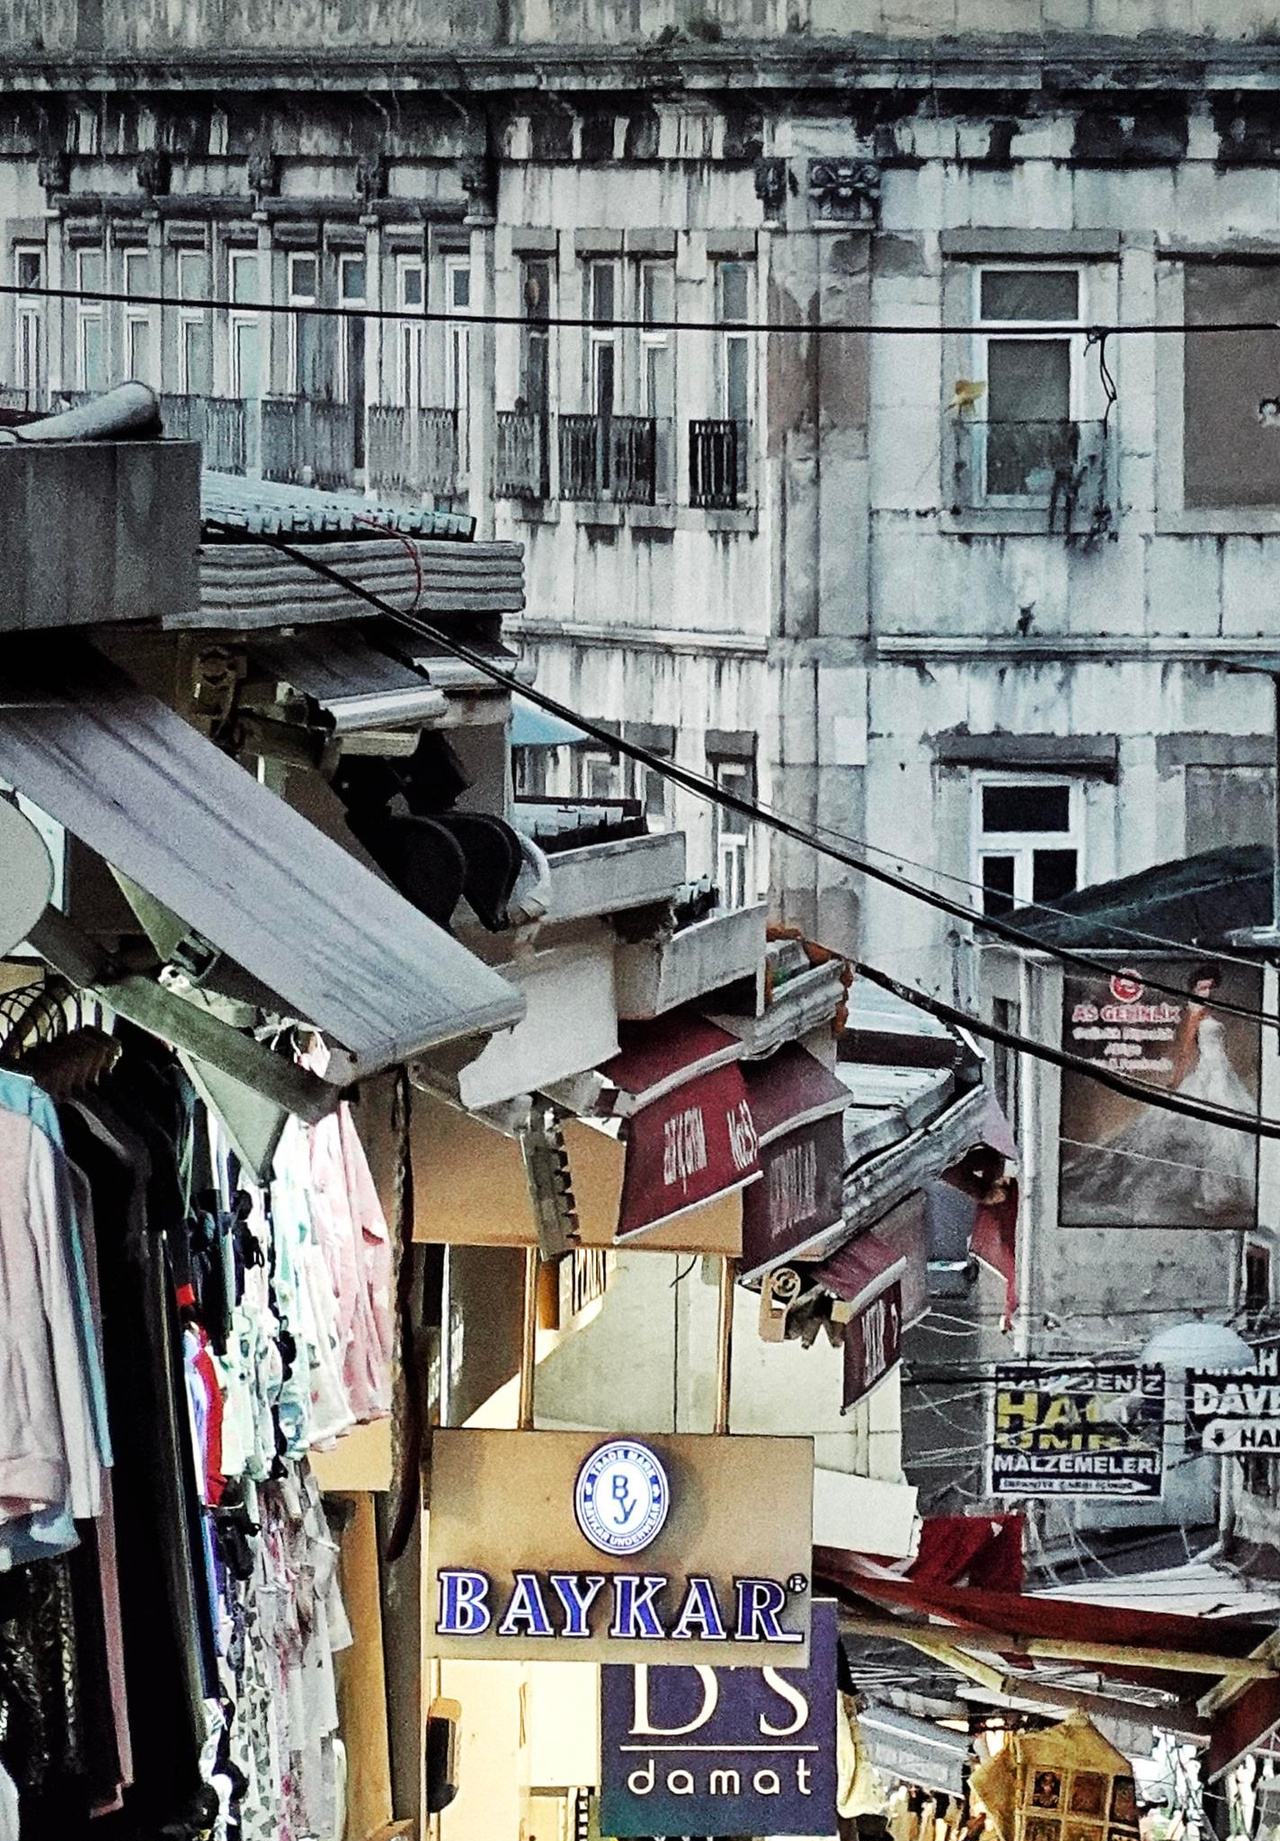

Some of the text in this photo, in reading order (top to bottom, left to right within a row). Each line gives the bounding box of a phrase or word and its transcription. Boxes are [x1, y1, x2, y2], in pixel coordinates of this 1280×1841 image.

[437, 1571, 803, 1642] BAYKAR
[627, 1663, 809, 1736] DS
[627, 1758, 812, 1796] damat
